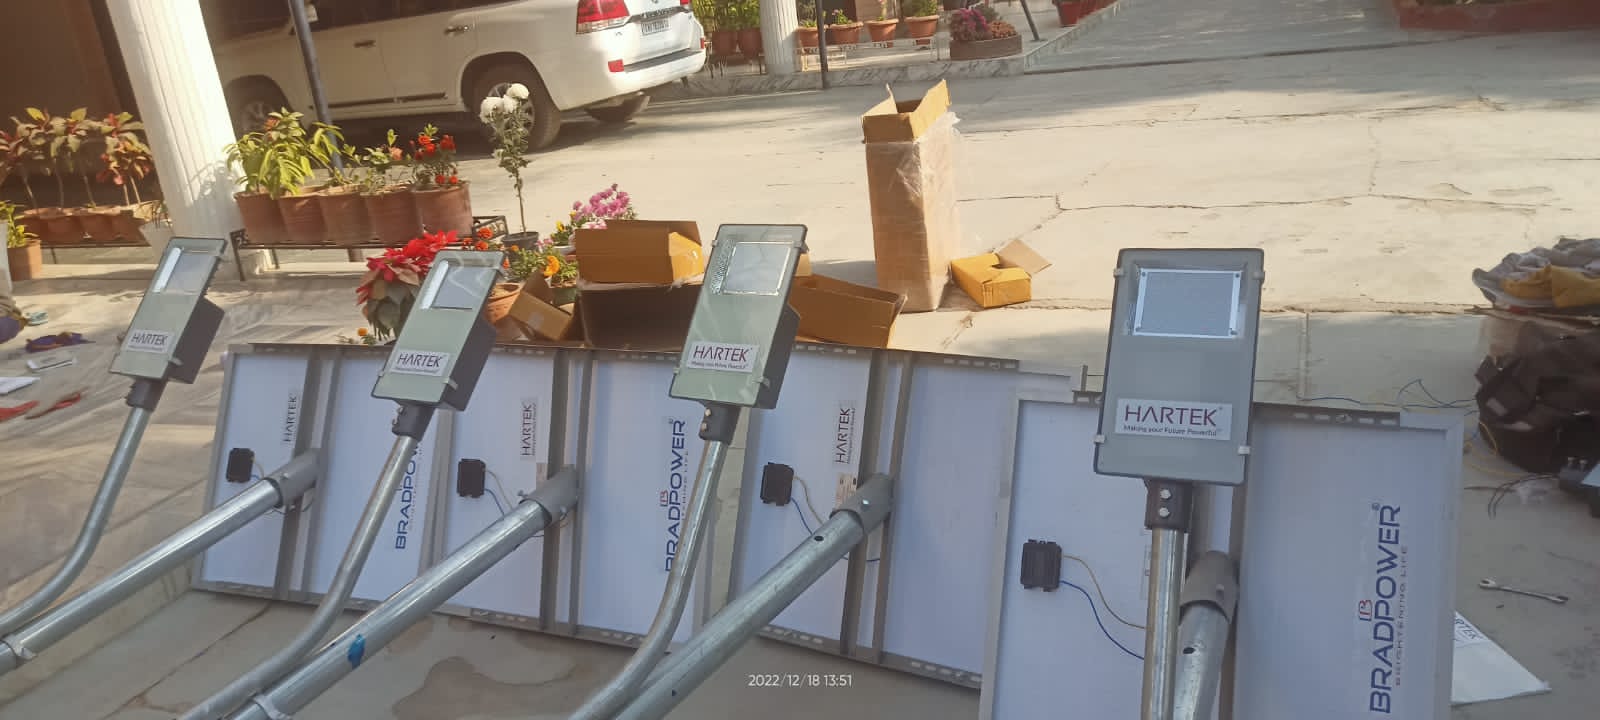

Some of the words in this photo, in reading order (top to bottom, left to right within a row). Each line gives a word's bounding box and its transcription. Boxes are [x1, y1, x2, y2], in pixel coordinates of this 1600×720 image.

[397, 353, 443, 367] HARTEK
[693, 345, 749, 362] HARTEK
[1124, 404, 1217, 427] HARTEK
[521, 403, 533, 456] HARTEK
[834, 407, 851, 464] HARTEK
[1123, 424, 1147, 434] Making
[1149, 426, 1163, 434] your
[1164, 426, 1186, 436] Future
[1187, 428, 1217, 438] Powerful
[1369, 504, 1401, 714] BRADPOWER
